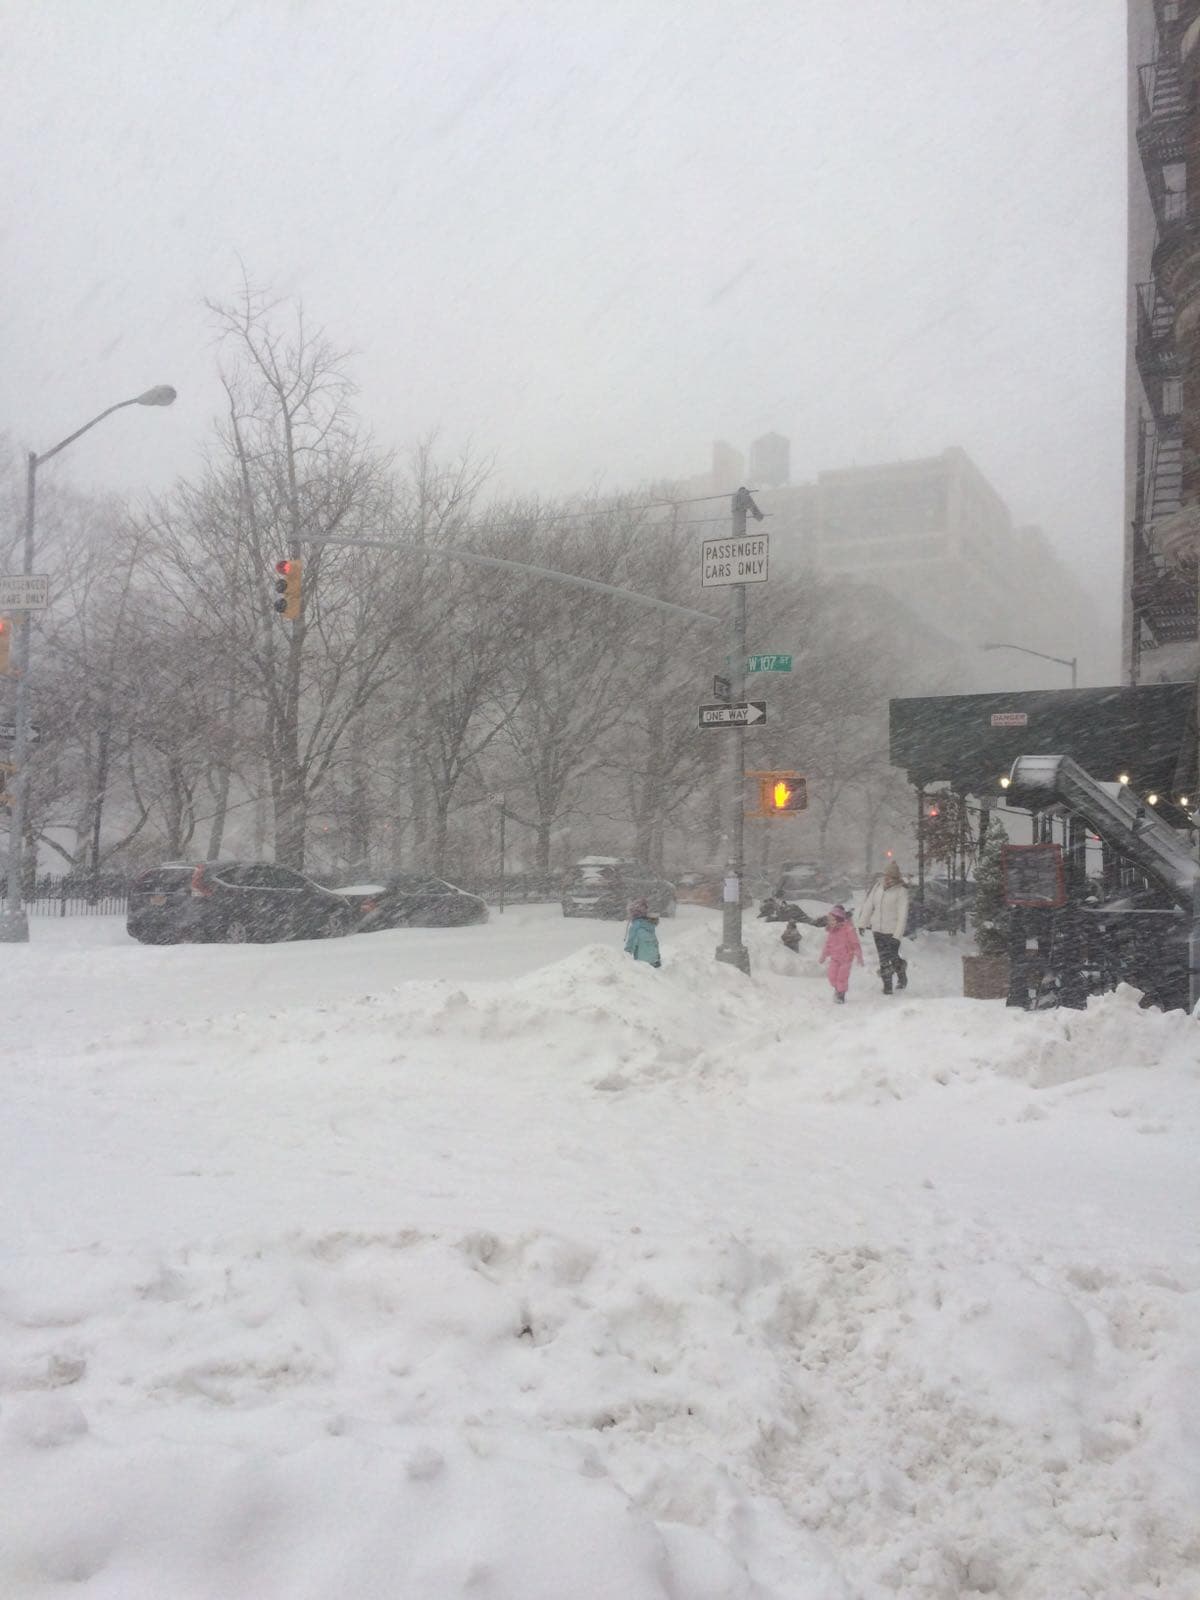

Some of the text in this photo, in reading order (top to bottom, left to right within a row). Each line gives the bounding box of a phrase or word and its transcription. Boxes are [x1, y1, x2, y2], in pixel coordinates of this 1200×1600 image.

[706, 541, 764, 560] PASSENGER
[705, 560, 764, 579] CARS ONLY
[748, 656, 757, 671] W
[706, 709, 748, 721] ONE WAY
